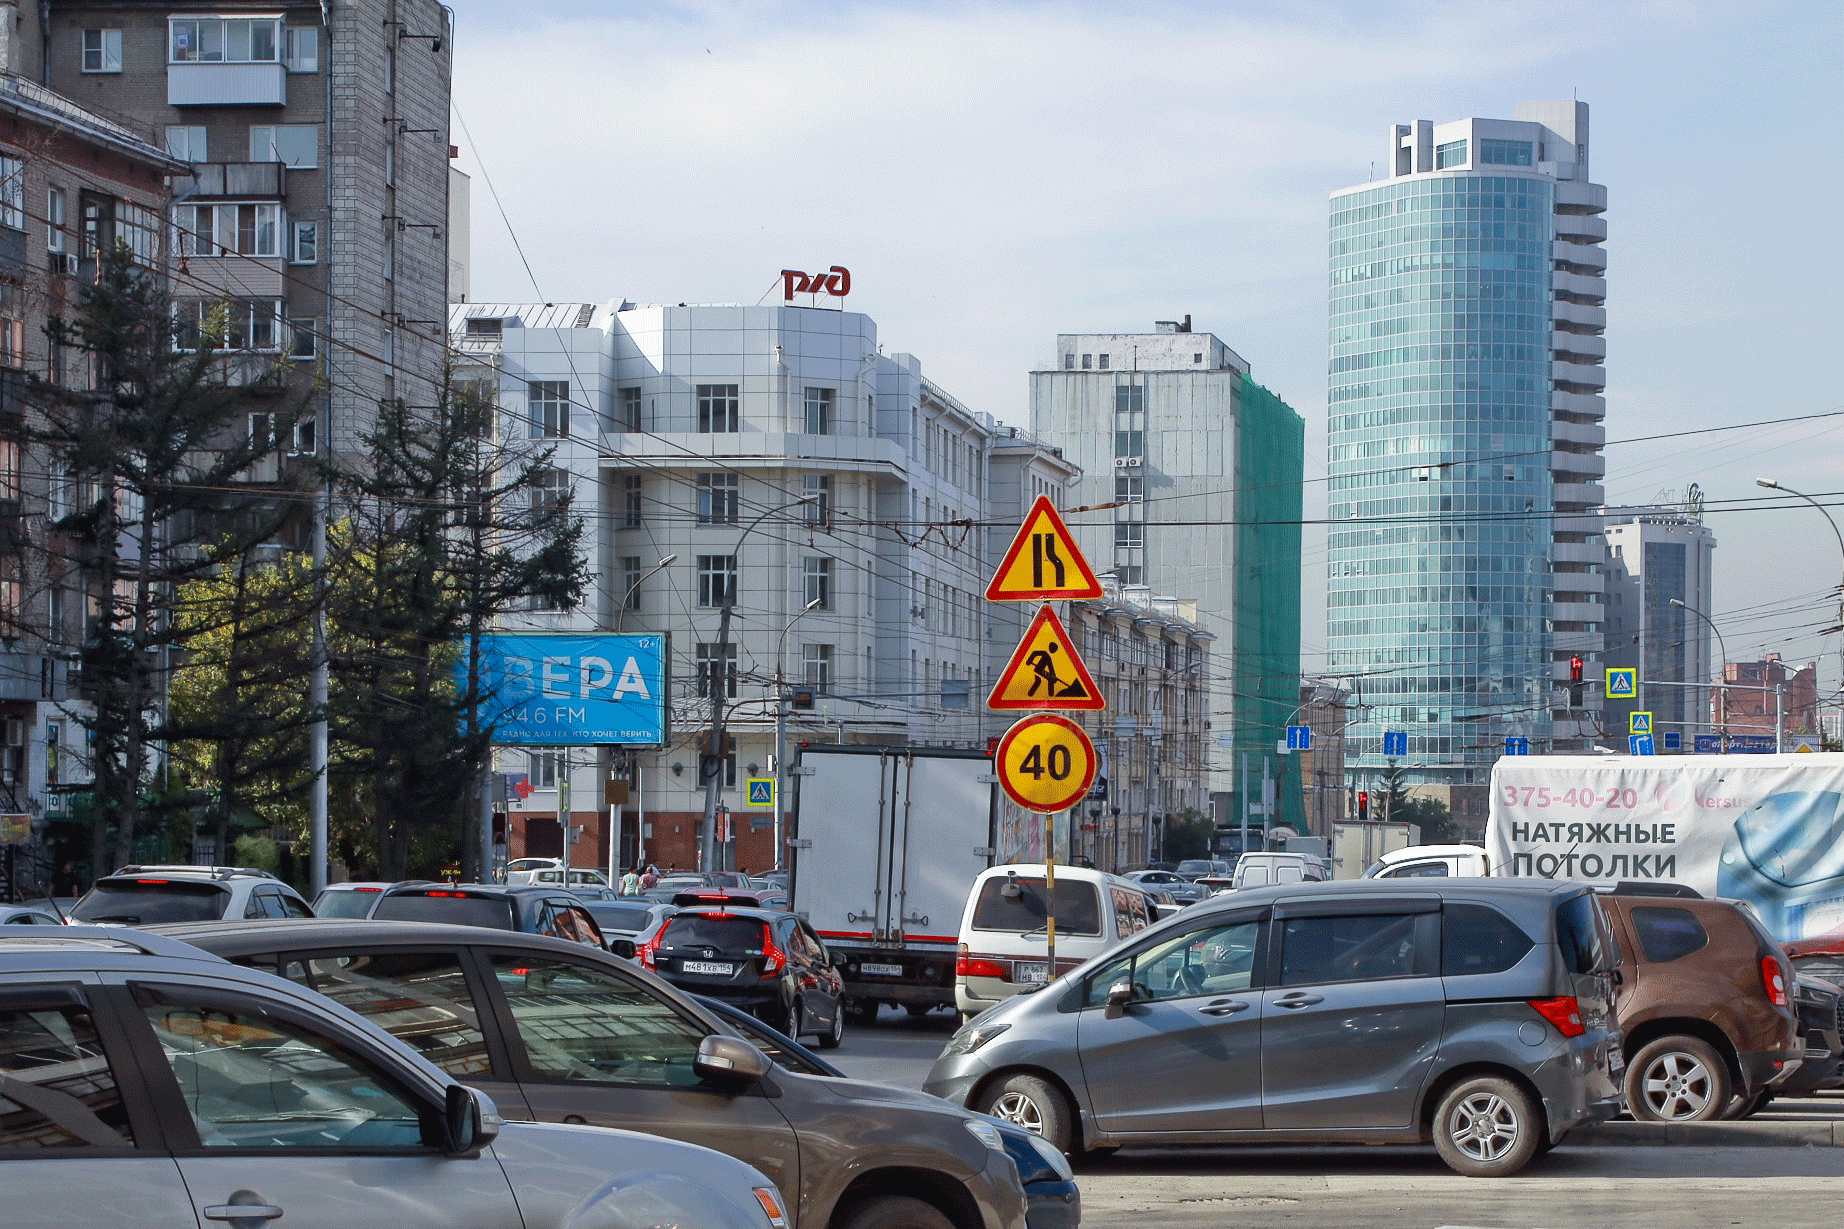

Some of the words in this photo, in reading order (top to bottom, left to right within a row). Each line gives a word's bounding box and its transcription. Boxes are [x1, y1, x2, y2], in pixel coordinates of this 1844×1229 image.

[639, 639, 655, 648] 12+
[504, 656, 651, 699] ВЕРА
[503, 707, 547, 723] 94.6
[555, 707, 586, 723] FM
[534, 730, 550, 738] ДЛЯ
[573, 730, 589, 738] КТО
[591, 730, 618, 738] ХОЧЕТ
[620, 730, 652, 738] ВЕРИТЬ
[1019, 744, 1071, 780] 40
[1503, 785, 1638, 809] 375-40-20
[1512, 821, 1676, 844] НАТЯЖНЫЕ
[1513, 852, 1676, 878] ПОТОЛКИ
